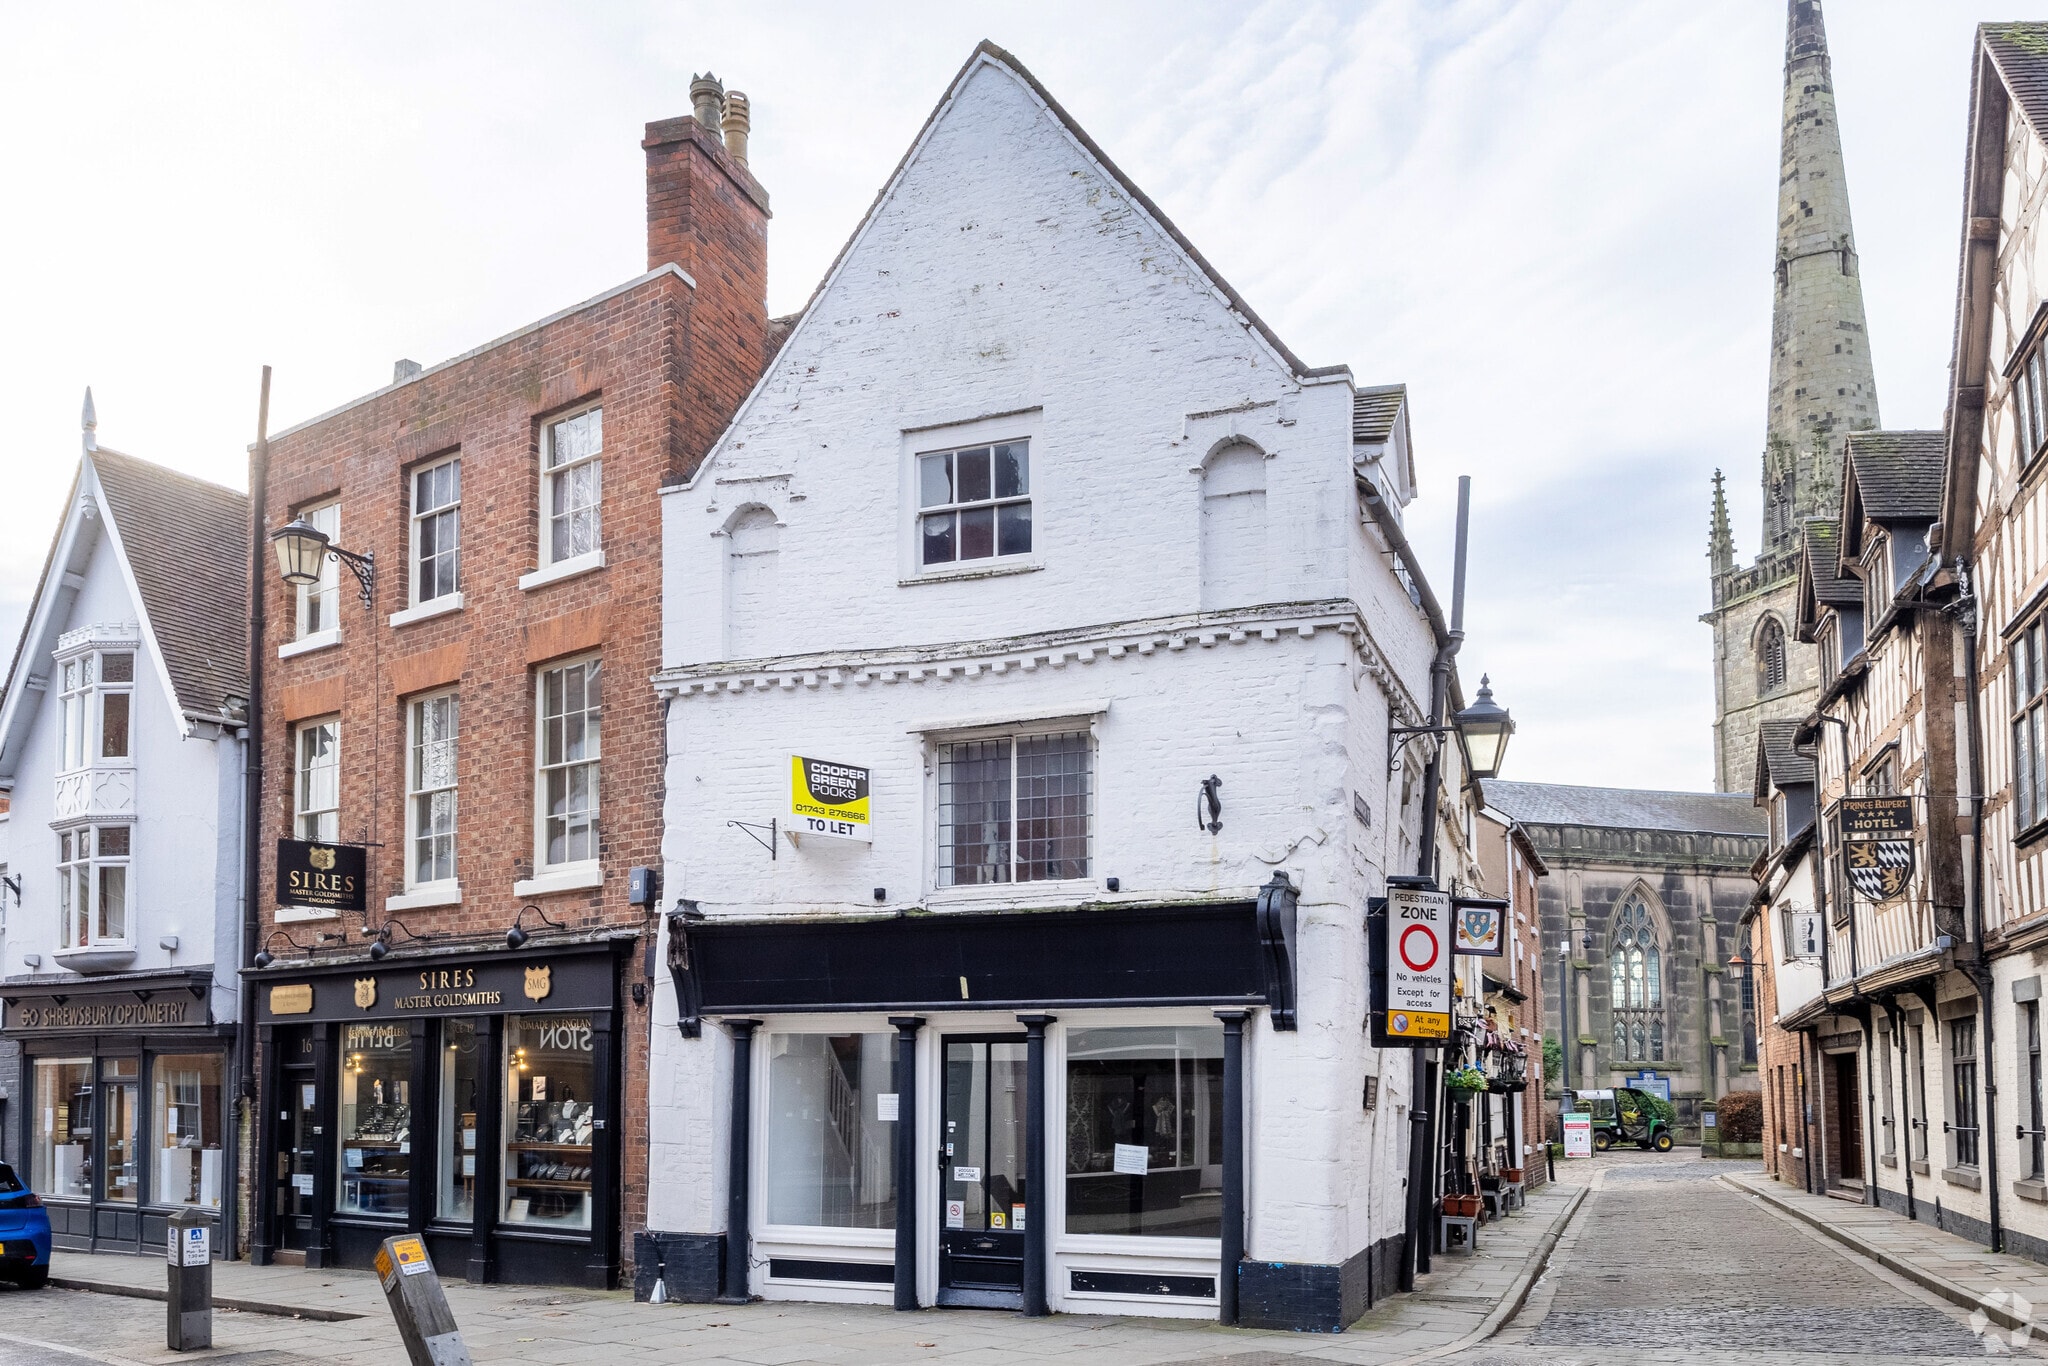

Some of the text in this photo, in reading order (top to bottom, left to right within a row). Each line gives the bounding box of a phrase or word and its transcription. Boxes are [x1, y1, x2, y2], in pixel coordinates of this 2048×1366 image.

[810, 762, 866, 781] COOPER
[810, 773, 857, 789] GREEN
[811, 783, 857, 800] POOKS
[795, 803, 866, 821] 01743 276666
[1843, 800, 1873, 811] PRINCE
[806, 817, 855, 836] TO LET
[1854, 818, 1898, 829] HOTEL
[289, 870, 355, 892] SIRES
[289, 888, 354, 899] MASTER GOLDSMITHS
[1394, 893, 1444, 905] PEDESTRIAN
[1400, 906, 1438, 921] ZONE
[419, 968, 475, 990] SIRES
[527, 977, 546, 990] SMG
[1396, 972, 1442, 984] No vehicles
[1397, 987, 1441, 998] Except for
[394, 991, 501, 1009] MASTER GOLDSMITHS
[1406, 1000, 1433, 1008] access
[43, 1004, 115, 1027] SHREWSBURY
[117, 1001, 187, 1025] OPTOMETRY
[1414, 1015, 1441, 1026] At any
[562, 1018, 592, 1029] ENGLAN
[1418, 1026, 1435, 1035] time
[302, 1038, 313, 1053] 16
